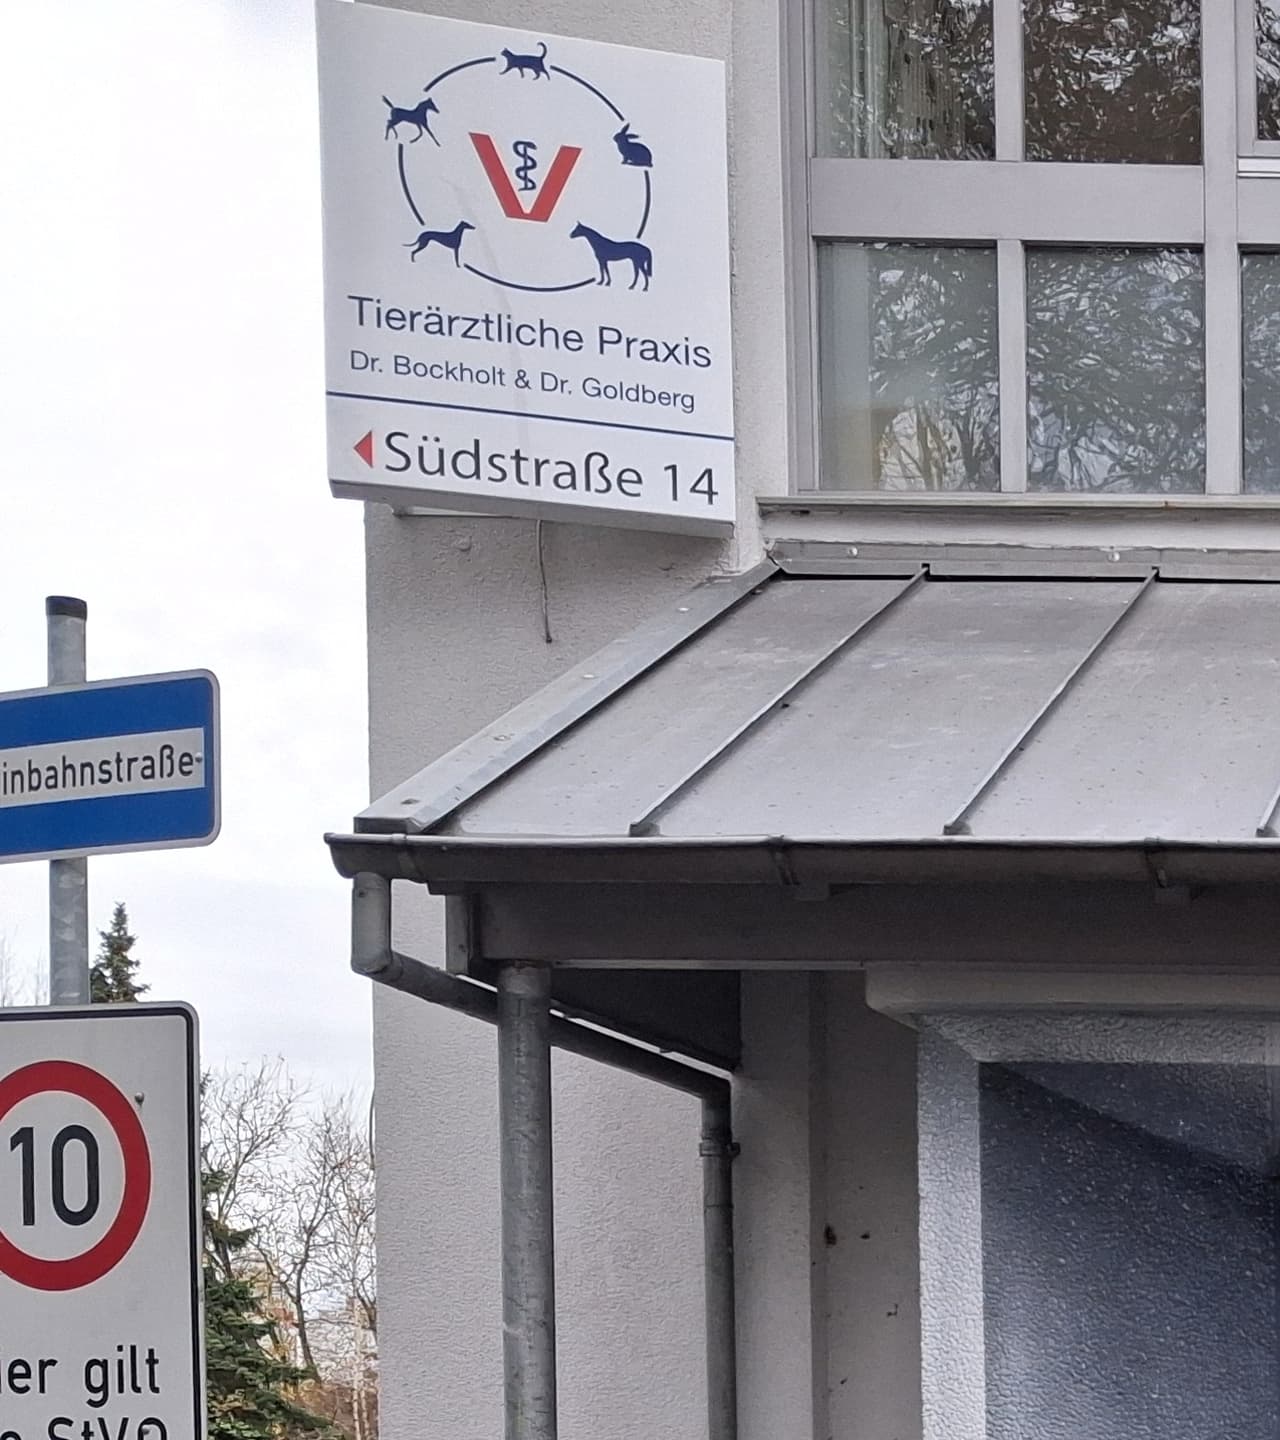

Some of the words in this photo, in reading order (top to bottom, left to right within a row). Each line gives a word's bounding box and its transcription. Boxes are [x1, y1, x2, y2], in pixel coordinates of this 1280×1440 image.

[347, 295, 584, 352] Tierärztliche
[598, 325, 712, 368] Praxis
[350, 350, 383, 373] Dr.
[393, 354, 506, 387] Bockholt
[514, 368, 532, 390] &
[540, 371, 573, 395] Dr.
[582, 376, 695, 414] Goldberg
[384, 431, 644, 498] Südstraße
[663, 463, 719, 505] 14
[3, 744, 194, 795] inbahnstraße
[9, 1124, 100, 1227] 10
[84, 1344, 161, 1409] gilt
